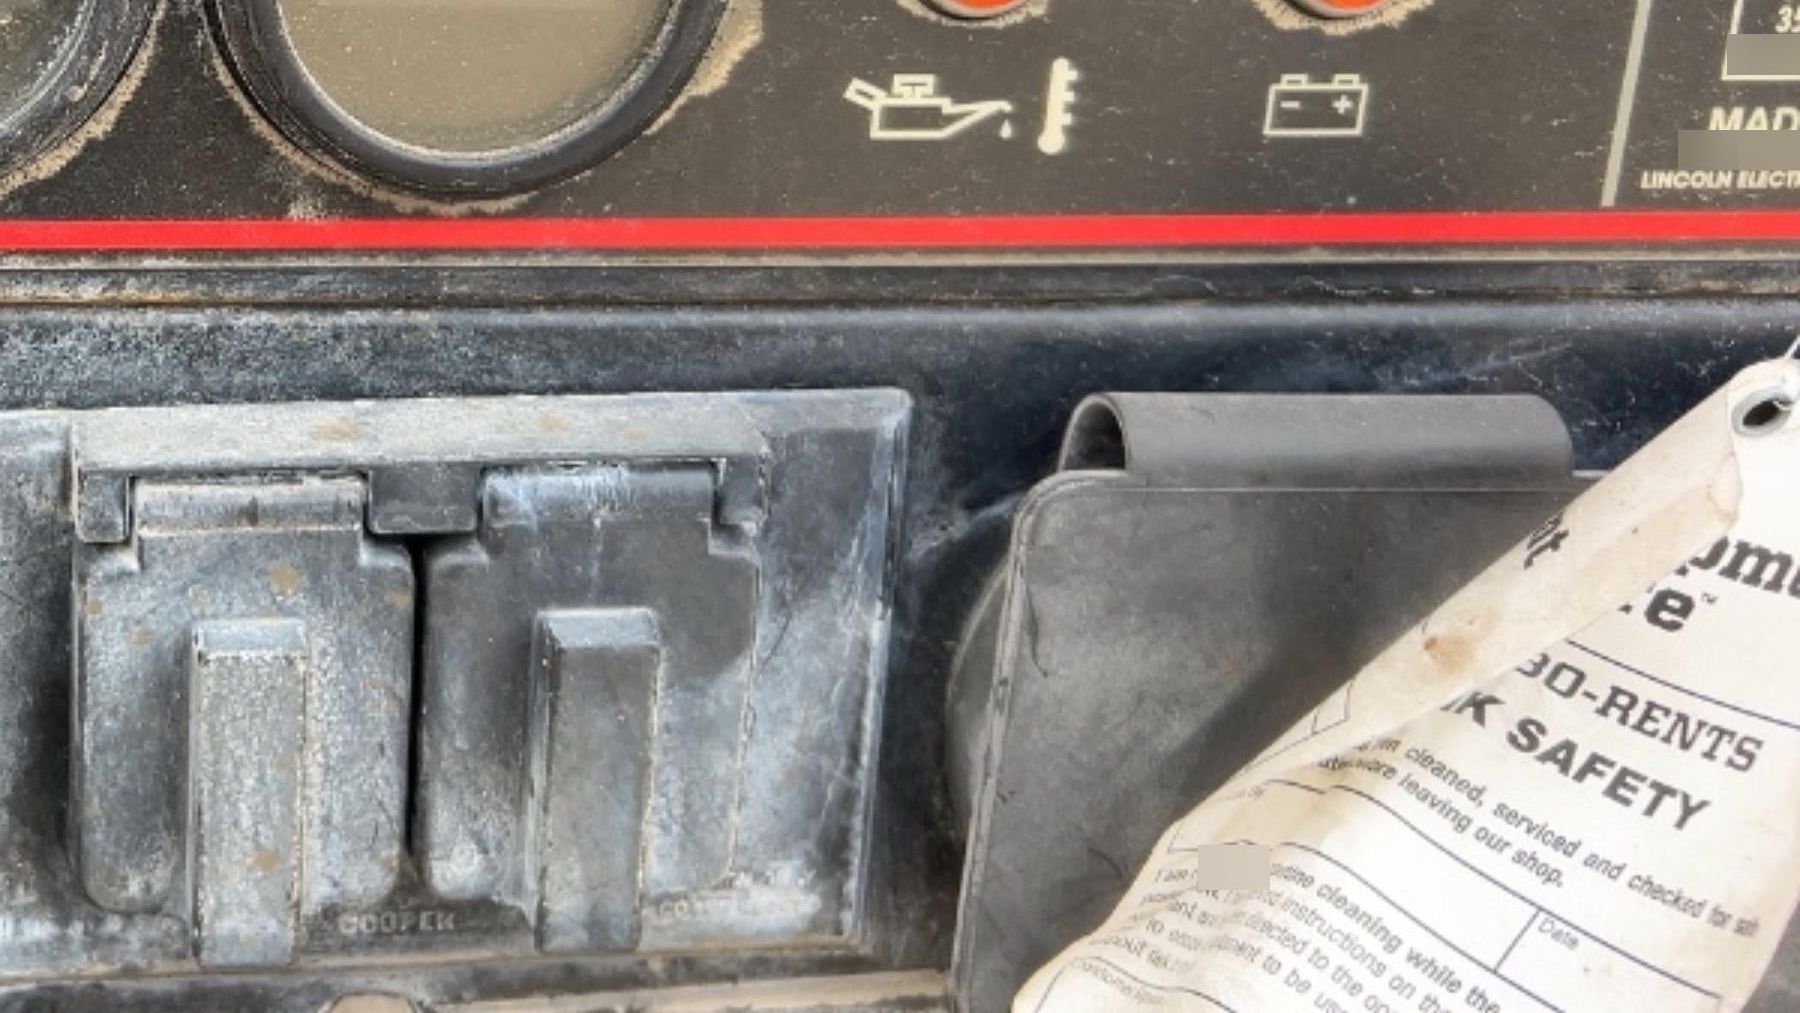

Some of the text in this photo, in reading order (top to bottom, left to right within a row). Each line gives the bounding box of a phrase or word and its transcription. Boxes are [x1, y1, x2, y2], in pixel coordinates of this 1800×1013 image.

[1639, 169, 1733, 189] LINCOLN
[1505, 717, 1712, 831] SAFETY
[1397, 772, 1474, 834] leaving
[1473, 823, 1513, 854] our
[1511, 846, 1566, 888] shop.
[1404, 745, 1488, 807] cleaned,
[1492, 801, 1582, 859] serviced
[1582, 851, 1627, 882] and
[1627, 873, 1707, 920] checked
[1262, 954, 1282, 976] to
[1283, 967, 1312, 994] be
[1279, 897, 1387, 979] instructions
[1388, 974, 1417, 1001] on
[1306, 944, 1330, 970] to
[1331, 963, 1363, 998] the
[1315, 882, 1403, 955] cleaning
[1405, 947, 1463, 994] while
[1465, 985, 1501, 1013] the
[1537, 916, 1580, 950] Date
